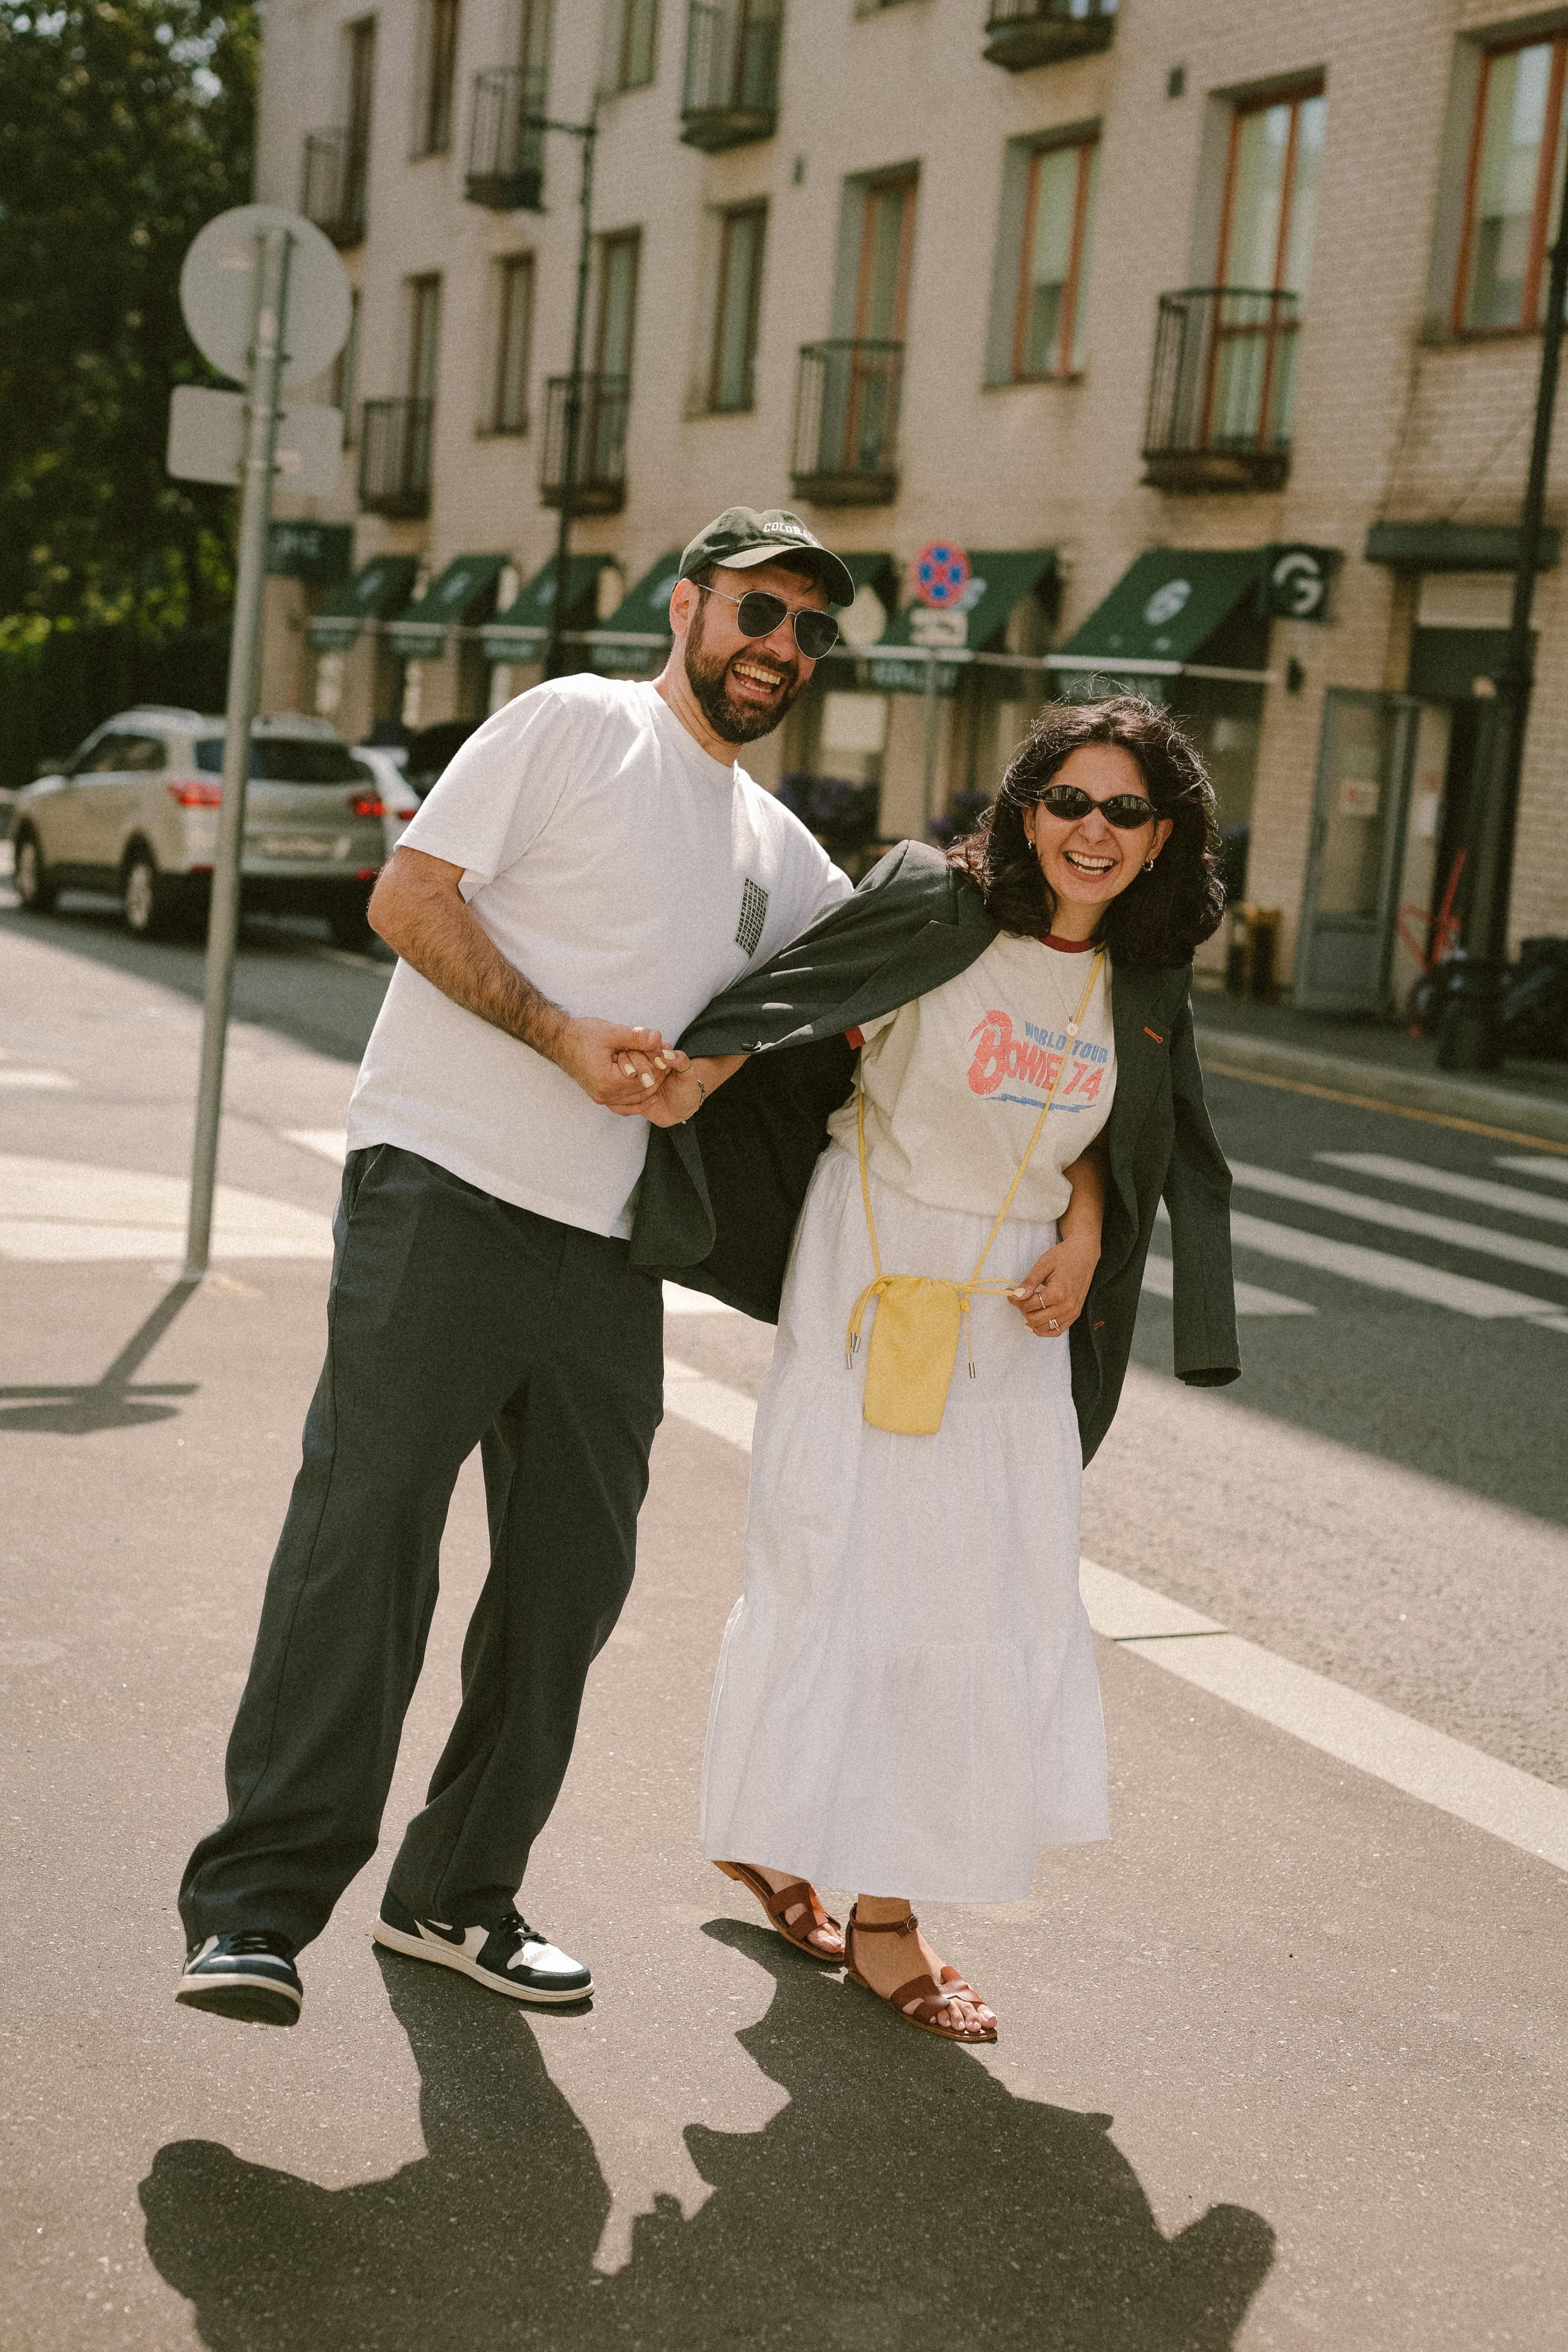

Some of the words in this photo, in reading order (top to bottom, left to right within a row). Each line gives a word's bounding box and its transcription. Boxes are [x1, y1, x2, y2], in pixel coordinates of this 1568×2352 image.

[967, 1009, 1064, 1095] BOWIE
[1062, 1060, 1104, 1101] 74
[1025, 1021, 1067, 1051] WORLD
[1072, 1039, 1109, 1063] TOUR
